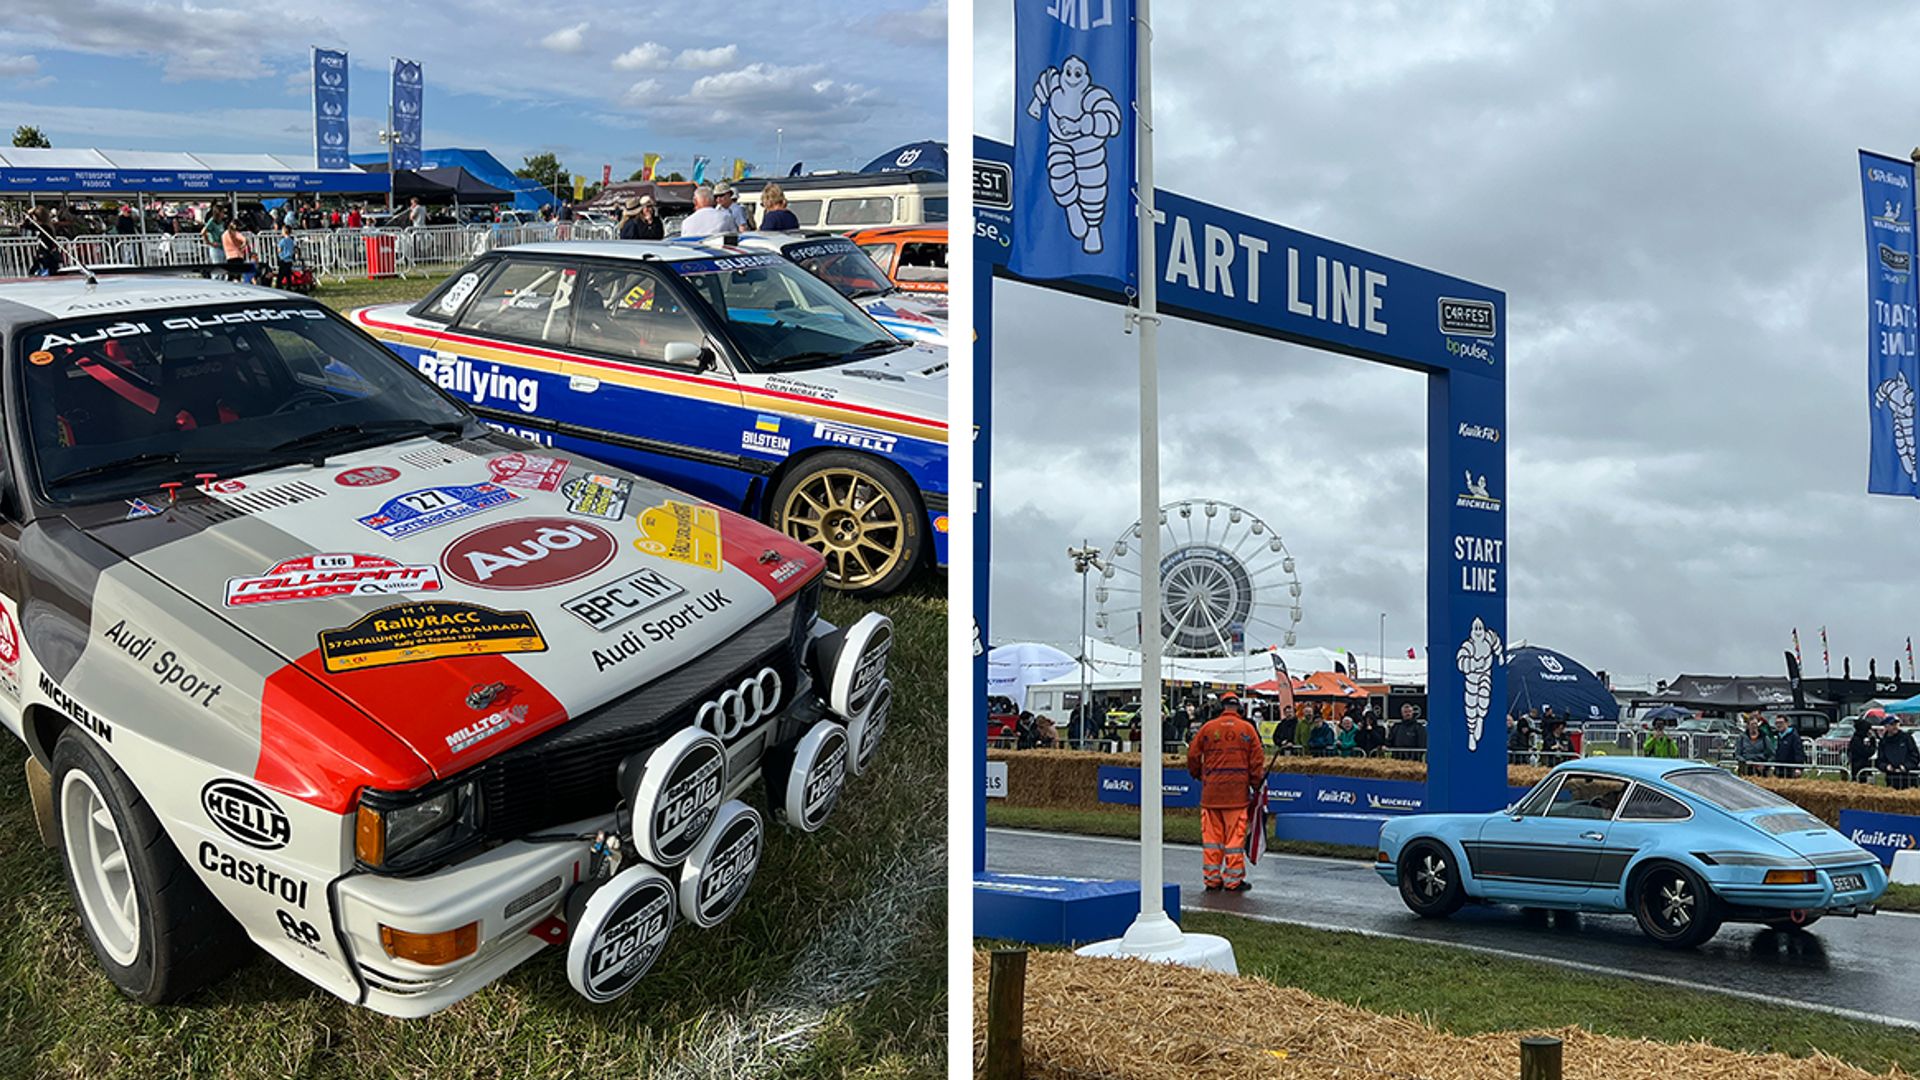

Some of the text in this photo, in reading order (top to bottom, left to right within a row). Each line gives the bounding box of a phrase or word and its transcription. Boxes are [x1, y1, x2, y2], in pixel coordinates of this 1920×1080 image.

[1136, 209, 1387, 335] ART LINE
[67, 298, 132, 310] Audi
[40, 308, 326, 351] Audi quattro
[418, 354, 538, 412] Rallying
[742, 431, 790, 450] BILSTEIN
[813, 422, 898, 453] PIRELLI
[405, 491, 446, 511] 27
[1456, 498, 1501, 511] MICHELIN
[464, 525, 598, 581] Audi
[1455, 535, 1502, 563] START
[1463, 566, 1497, 592] LINE
[374, 611, 481, 633] RallyRACC
[570, 588, 639, 625] BPC
[463, 623, 531, 634] DAURADA
[591, 588, 732, 672] Audi Sport UK
[104, 619, 223, 708] Audi Sport
[38, 672, 113, 743] MICHELIN
[809, 760, 844, 804] Hella
[1317, 790, 1352, 804] KwikFit
[1381, 797, 1421, 807] MICHELIN
[208, 793, 291, 844] HELLA
[662, 776, 717, 834] Hella
[1851, 829, 1908, 847] KwikFit
[199, 840, 308, 910] Castrol
[705, 844, 754, 899] Hella
[598, 913, 663, 972] Hella
